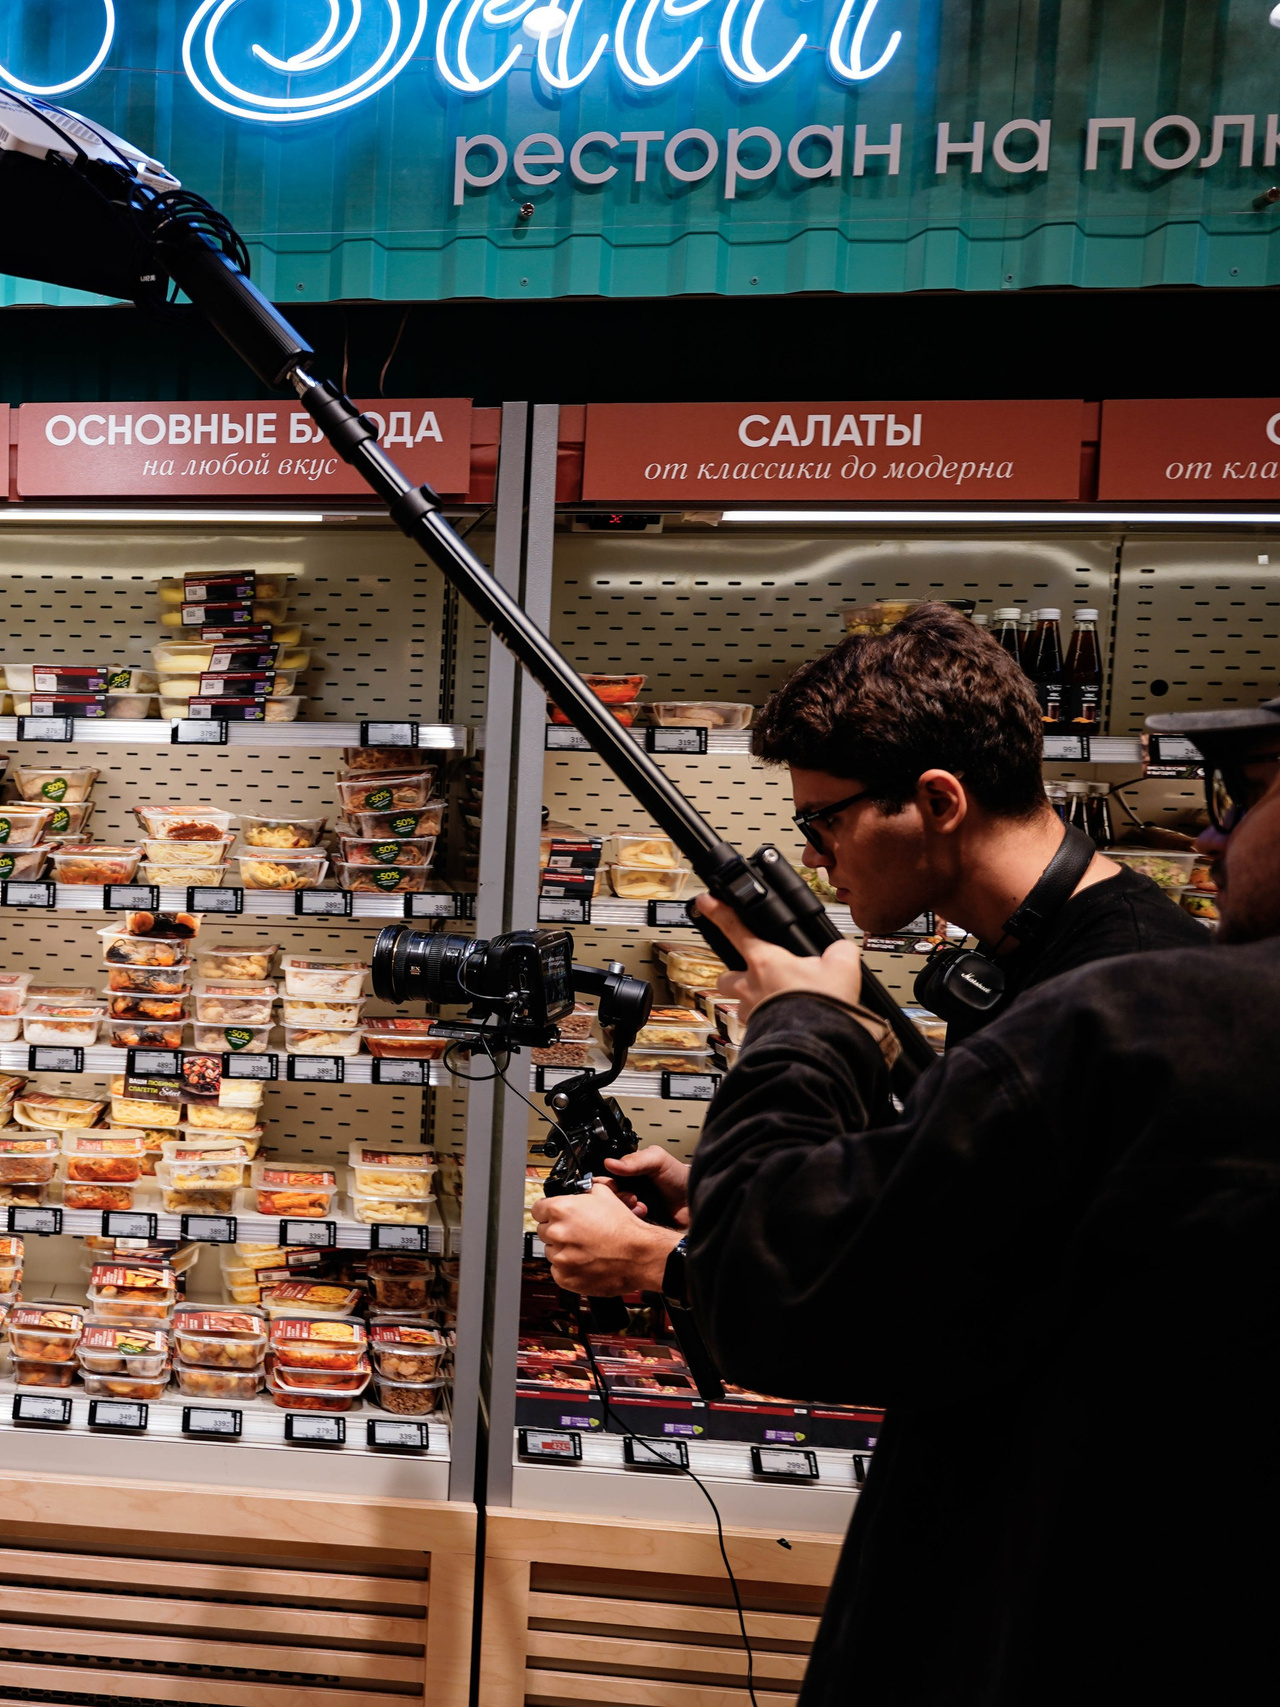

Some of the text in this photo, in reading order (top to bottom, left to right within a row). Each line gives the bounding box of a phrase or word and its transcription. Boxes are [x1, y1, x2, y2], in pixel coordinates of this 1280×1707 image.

[453, 123, 903, 206] ресторан
[936, 119, 1053, 174] на
[45, 411, 277, 447] ОСНОВНЫЕ
[738, 413, 922, 447] САЛАТЫ
[142, 452, 338, 481] на любой вкус
[644, 455, 1014, 485] от классики до модерна
[1166, 462, 1212, 480] от
[45, 781, 64, 793] -50%
[369, 790, 390, 803] -50%
[393, 817, 416, 828] -50%
[375, 844, 399, 854] -50%
[376, 871, 400, 881] -50%
[228, 1030, 250, 1040] -50%
